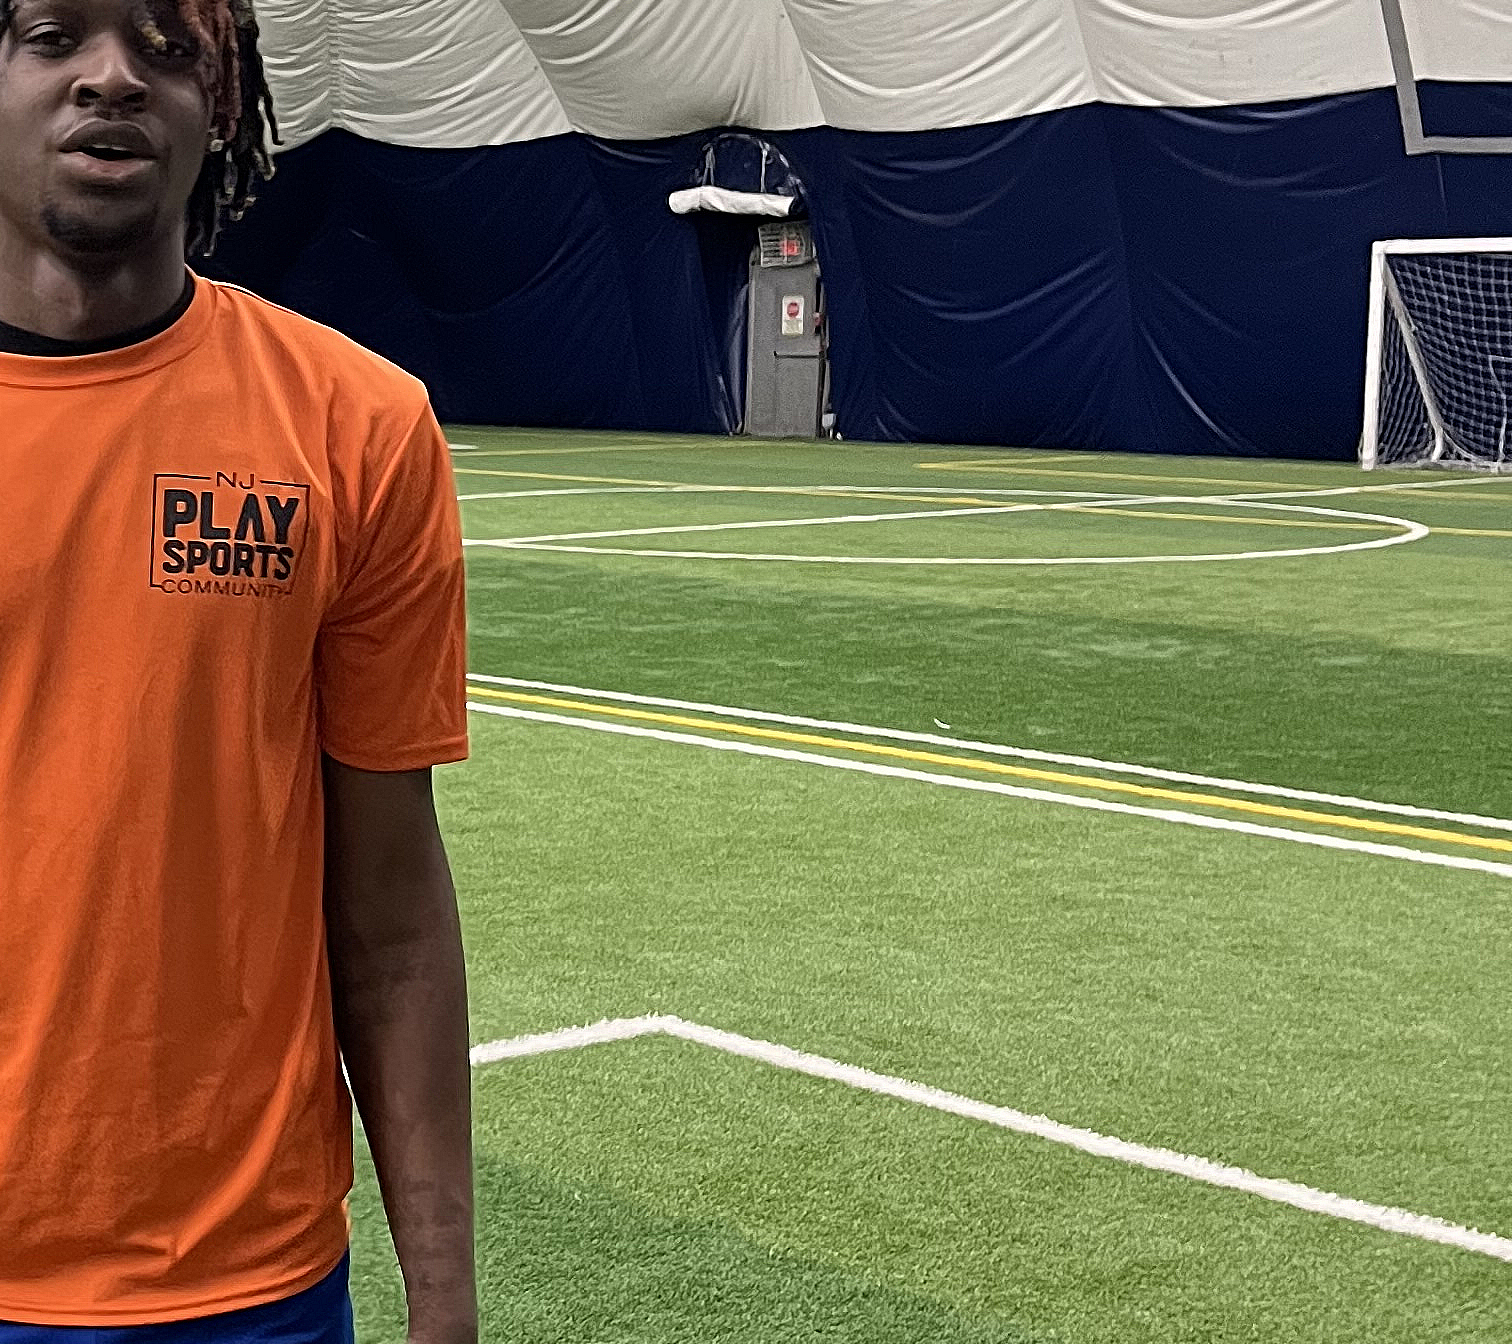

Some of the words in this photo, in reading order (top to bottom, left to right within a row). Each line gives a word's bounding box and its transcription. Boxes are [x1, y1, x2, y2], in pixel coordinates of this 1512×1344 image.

[216, 471, 255, 489] NJ
[163, 489, 299, 544] PLAY
[162, 540, 294, 580] SPORTS
[161, 579, 287, 598] COMMUNIT
